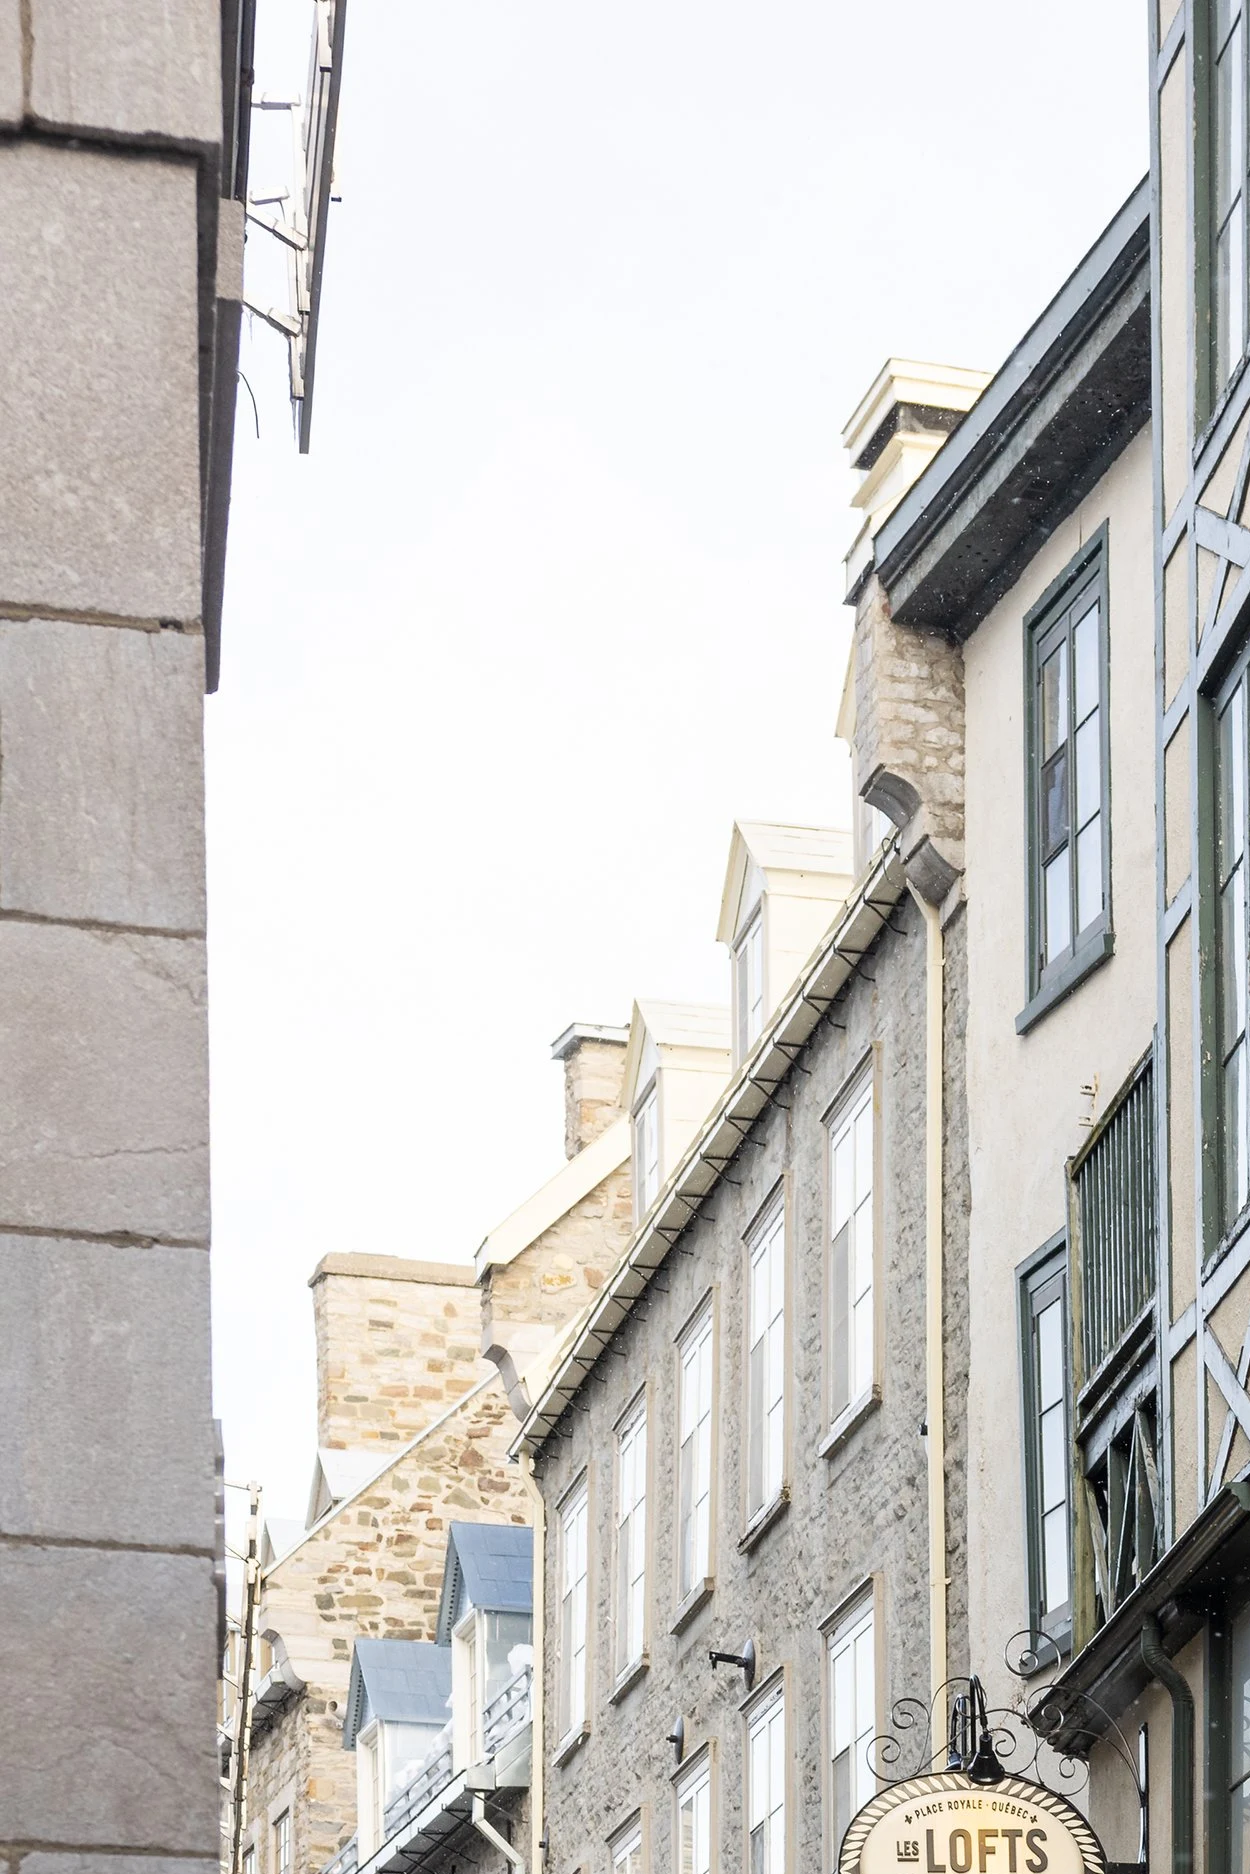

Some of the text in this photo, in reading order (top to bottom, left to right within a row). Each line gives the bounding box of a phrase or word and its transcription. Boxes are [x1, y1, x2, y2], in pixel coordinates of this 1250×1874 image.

[914, 1799, 1029, 1820] PLACE ROYALE QUÉBEC
[896, 1828, 1049, 1874] LES LOFTS
